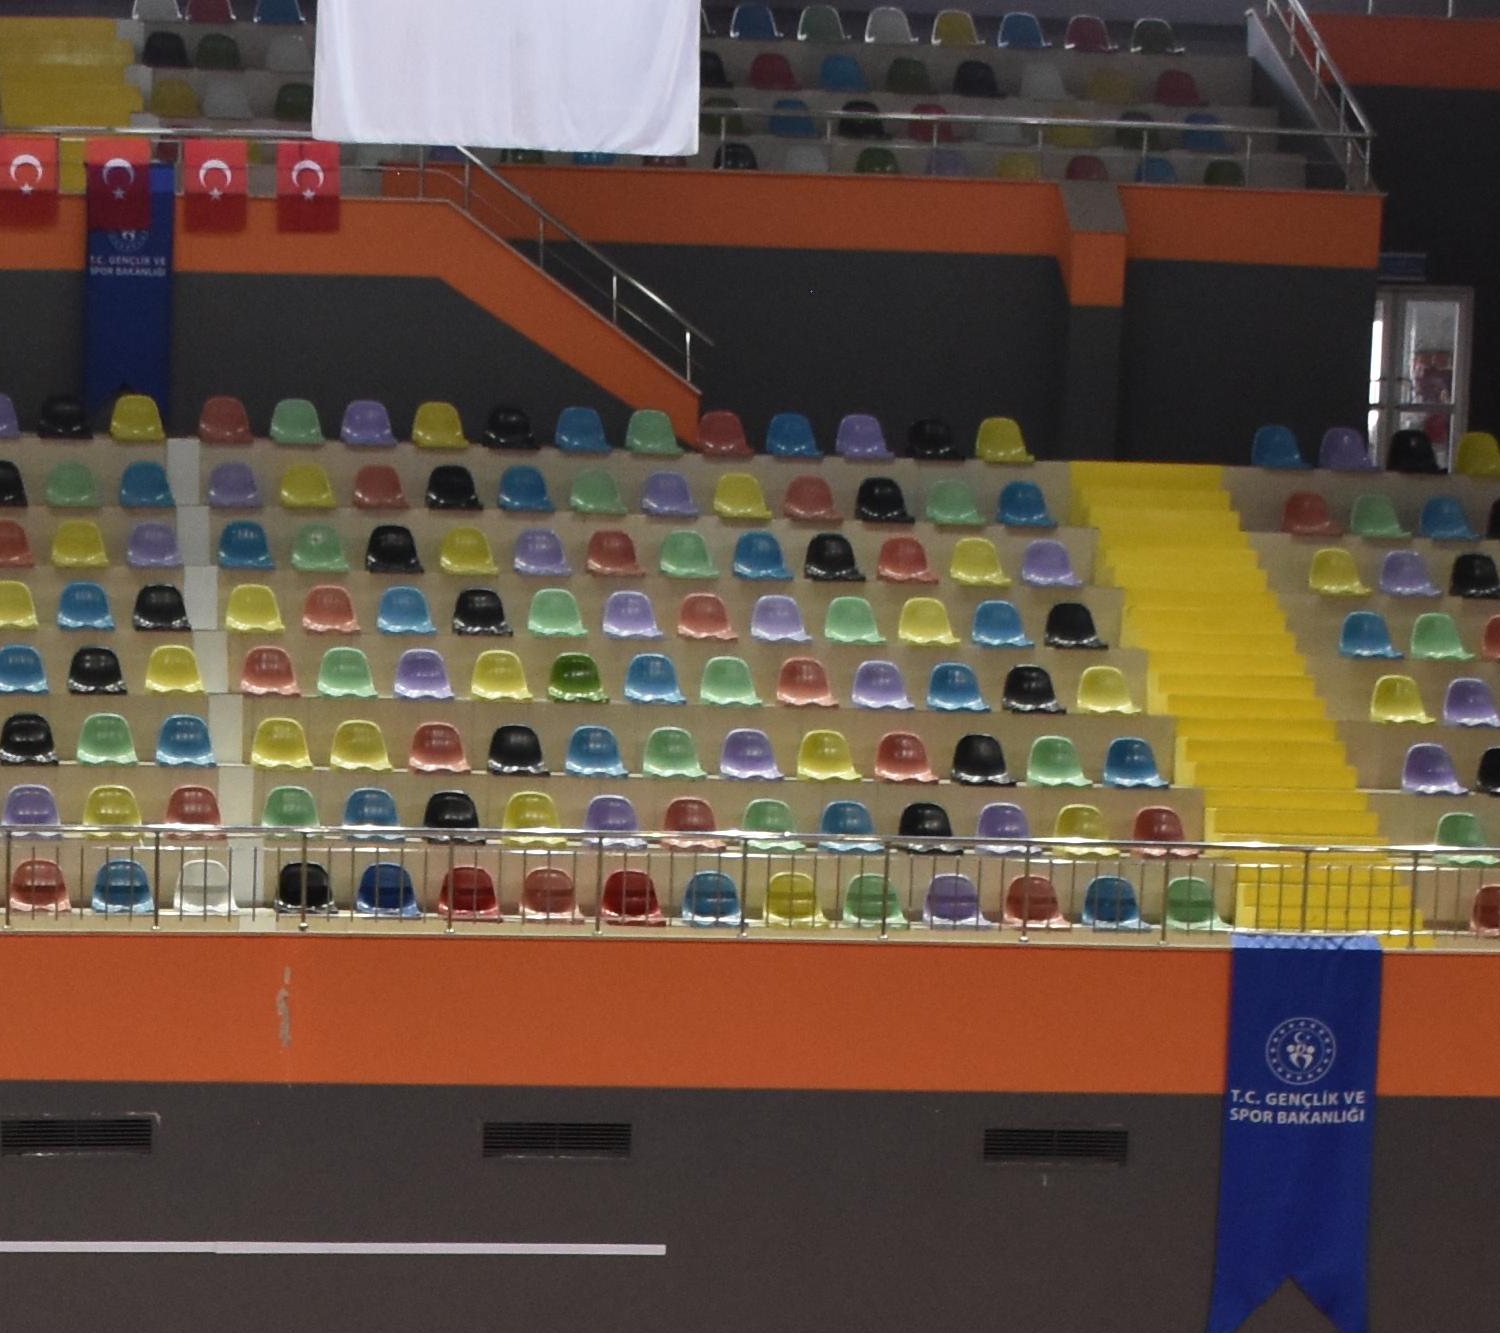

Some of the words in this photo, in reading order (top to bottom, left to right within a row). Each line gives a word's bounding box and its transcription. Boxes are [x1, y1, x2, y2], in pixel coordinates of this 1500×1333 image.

[1230, 1089, 1261, 1105] T.C.
[1265, 1090, 1338, 1109] GENÇLİK
[1344, 1090, 1366, 1104] VE
[1230, 1107, 1273, 1124] SPOR
[1277, 1106, 1366, 1125] BAKANLIĞI
